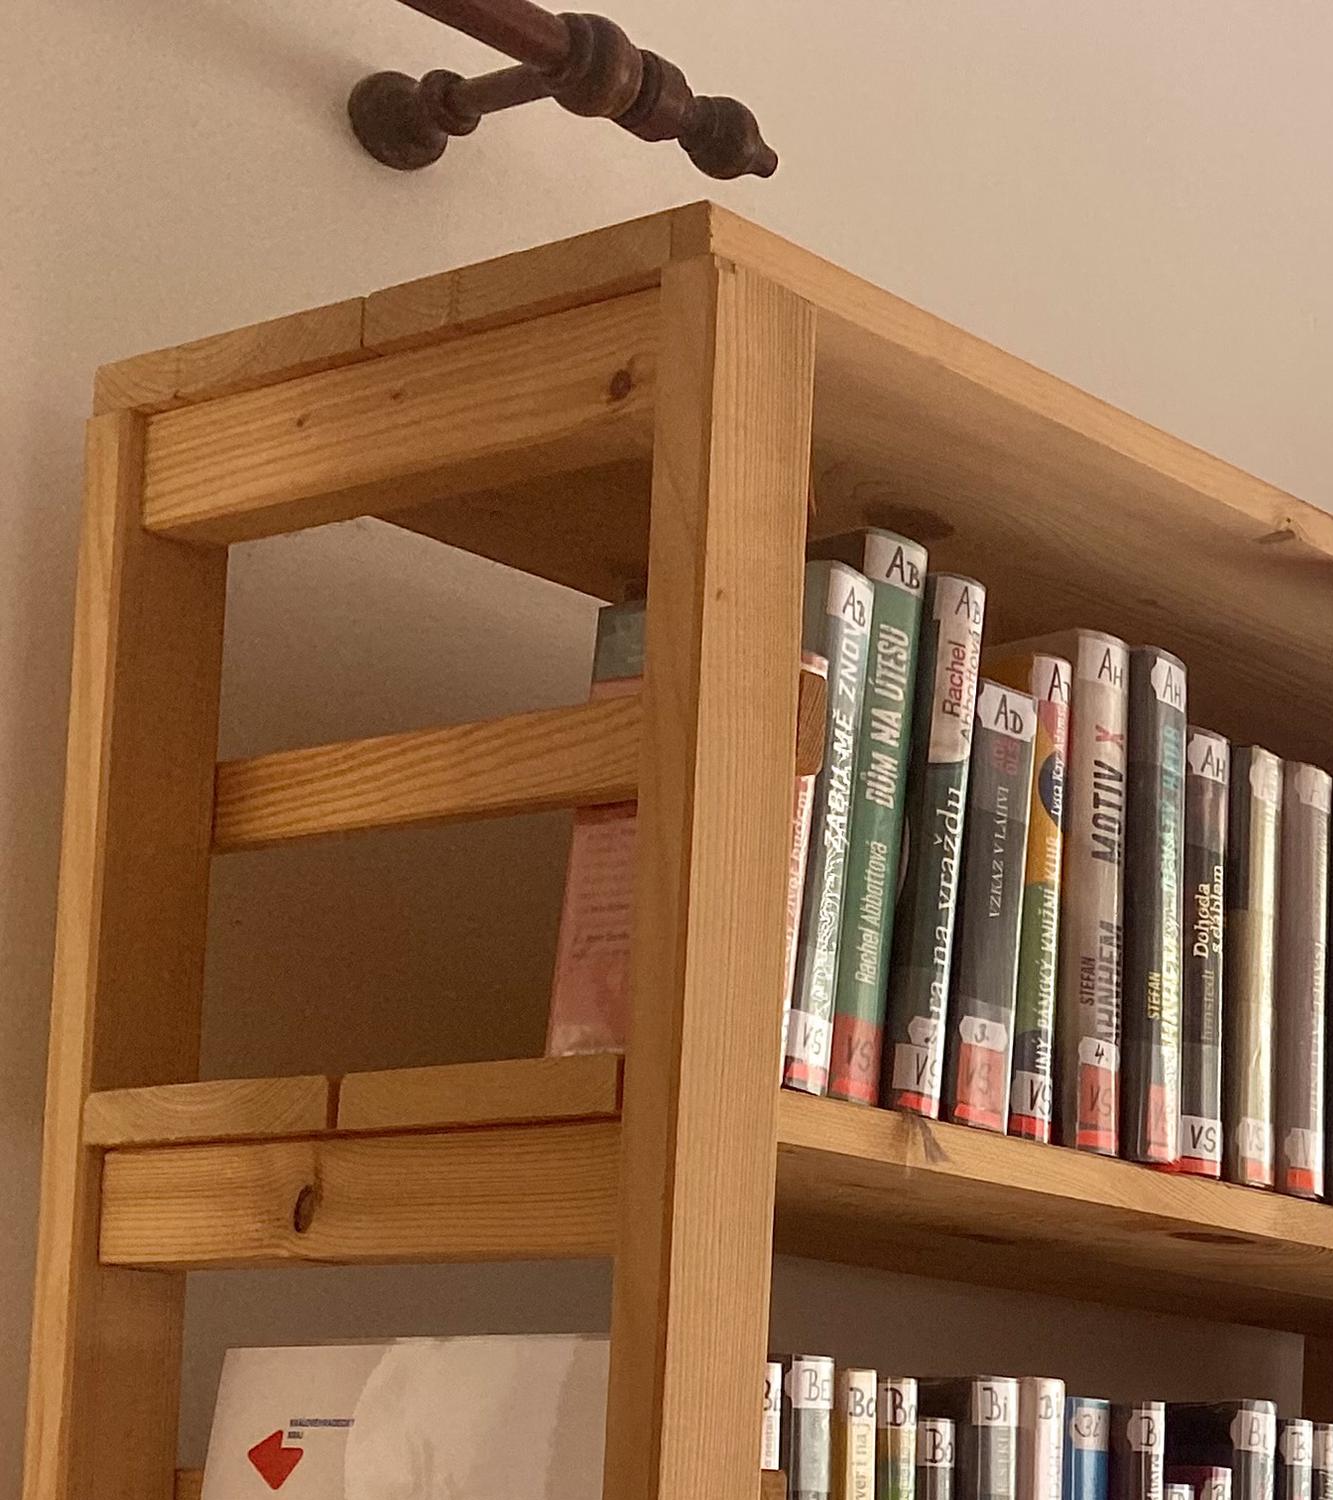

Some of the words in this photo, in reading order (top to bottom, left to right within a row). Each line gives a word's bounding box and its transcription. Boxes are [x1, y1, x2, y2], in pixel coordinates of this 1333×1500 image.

[870, 624, 910, 700] ÚTESU
[942, 639, 966, 717] Rachel
[870, 707, 902, 748] NA
[1094, 723, 1125, 750] X
[859, 766, 900, 810] DŮM
[1092, 759, 1126, 865] MOTIV
[861, 840, 888, 933] Abbottová
[988, 859, 1004, 919] VZKAZ
[1192, 883, 1211, 960] Dohoda
[855, 929, 880, 986] Rachel
[1079, 956, 1096, 1007] STEFAN
